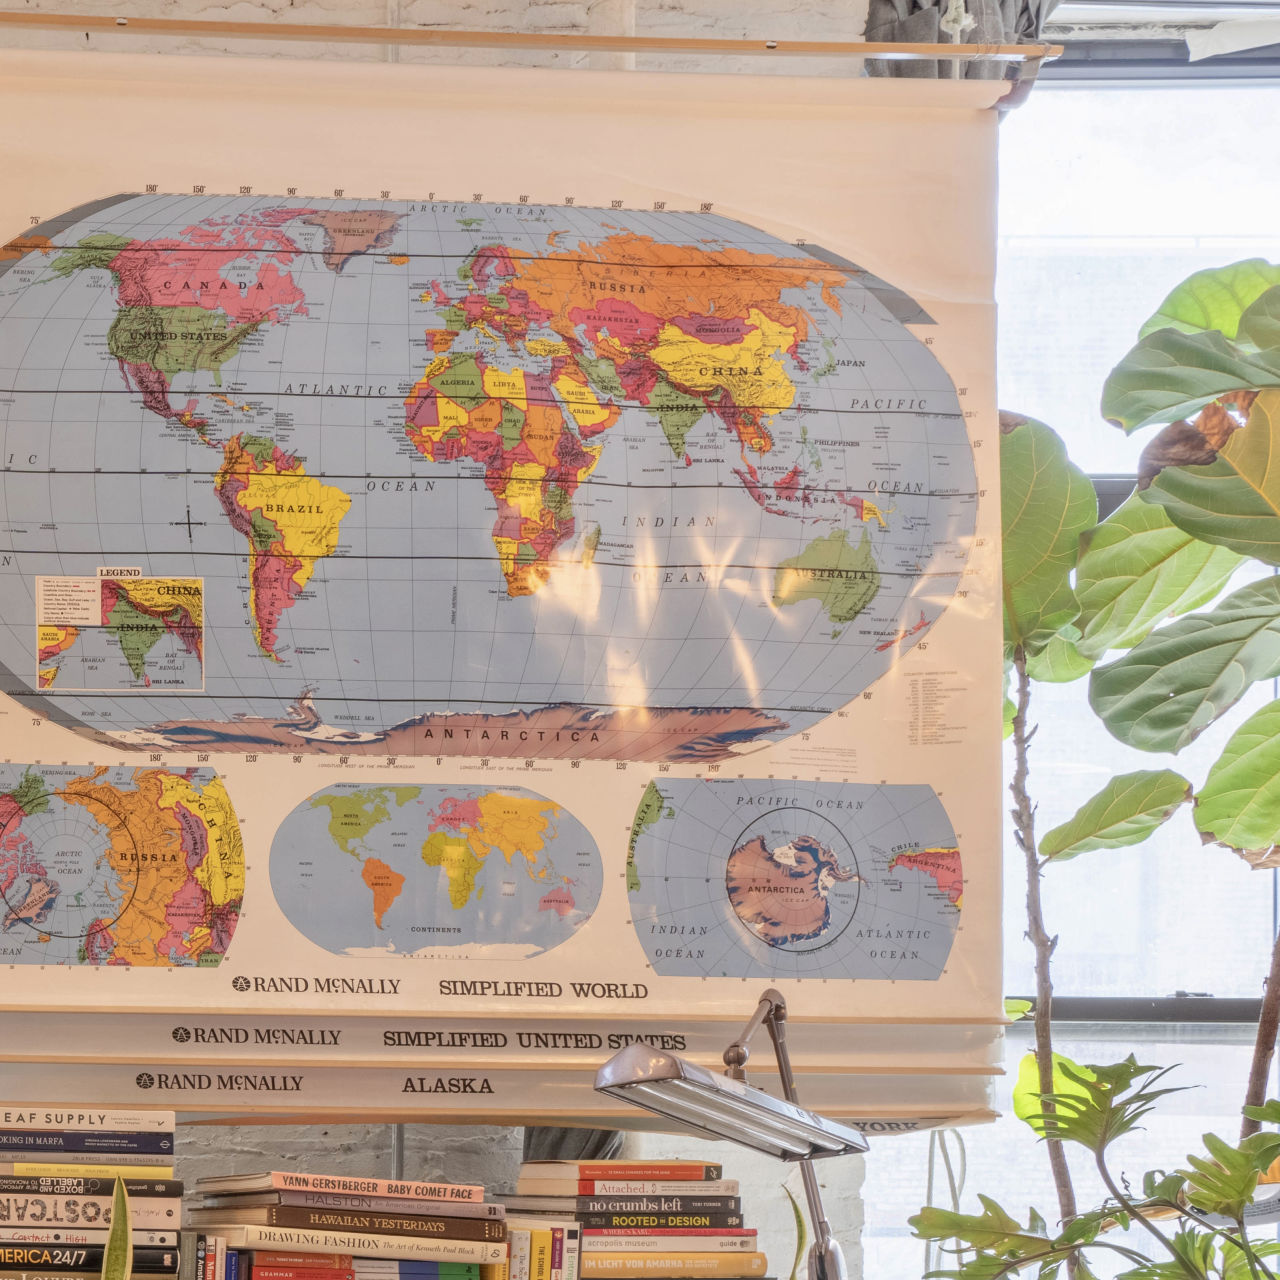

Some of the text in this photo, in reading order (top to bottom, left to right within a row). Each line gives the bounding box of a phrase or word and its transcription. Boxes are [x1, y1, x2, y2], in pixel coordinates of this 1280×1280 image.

[410, 205, 468, 213] ARCTIC
[164, 282, 264, 290] CANADA
[590, 281, 646, 293] RUSSIA
[130, 332, 227, 341] UNITED STATES
[699, 367, 763, 376] CHINA
[285, 384, 388, 396] ATLANTIC
[660, 403, 699, 411] INDIA
[851, 399, 928, 409] PACIFIC
[366, 481, 435, 492] OCEAN
[868, 481, 924, 492] OCEAN
[757, 495, 836, 503] INDONESIA
[266, 504, 324, 514] BRAZIL
[622, 517, 716, 527] INDIAN
[100, 569, 140, 577] LEGEND
[158, 586, 202, 596] CHINA
[120, 624, 157, 632] INDIA
[424, 728, 599, 743] ANTARCTICA
[737, 797, 864, 809] PACIFIC OCEAN
[627, 803, 651, 867] AUSTRALIA
[891, 842, 920, 852] CHILE
[120, 853, 177, 862] RUSSIA
[748, 886, 805, 894] ANTARCTICA
[651, 925, 708, 935] INDIAN
[856, 930, 931, 939] ATLANTIC
[655, 949, 704, 958] OCEAN
[870, 951, 919, 959] OCEAN
[253, 976, 309, 995] RAND
[439, 980, 563, 997] SIMPLIFIED
[570, 982, 648, 999] WORLD
[193, 1027, 249, 1046] RAND
[383, 1031, 507, 1049] SIMPLIFIED
[518, 1033, 602, 1049] UNITED
[608, 1034, 686, 1051] STATES
[157, 1072, 213, 1091] RAND
[401, 1077, 495, 1094] ALASKA
[45, 1114, 106, 1125] SUPPLY
[853, 1122, 919, 1131] YORK
[36, 1137, 64, 1145] MARFA
[40, 1178, 84, 1186] LABELLED
[283, 1175, 472, 1199] YANN GERSTBERGER BABY COMET FACE
[54, 1185, 83, 1193] BOXED
[600, 1183, 648, 1194] Attached.
[305, 1194, 371, 1208] HALSTON
[590, 1198, 683, 1211] no crumbs left
[310, 1214, 445, 1232] HAWAIIAN YESTERDAYS
[612, 1217, 657, 1226] ROOTED
[668, 1217, 710, 1226] DESIGN
[258, 1230, 320, 1246] DRAWING
[324, 1236, 380, 1249] FASHION
[383, 1241, 394, 1249] The
[407, 1242, 414, 1251] of
[416, 1244, 441, 1253] Kenneth
[443, 1246, 456, 1254] Paul
[458, 1247, 475, 1255] Block
[588, 1240, 622, 1248] acropolis
